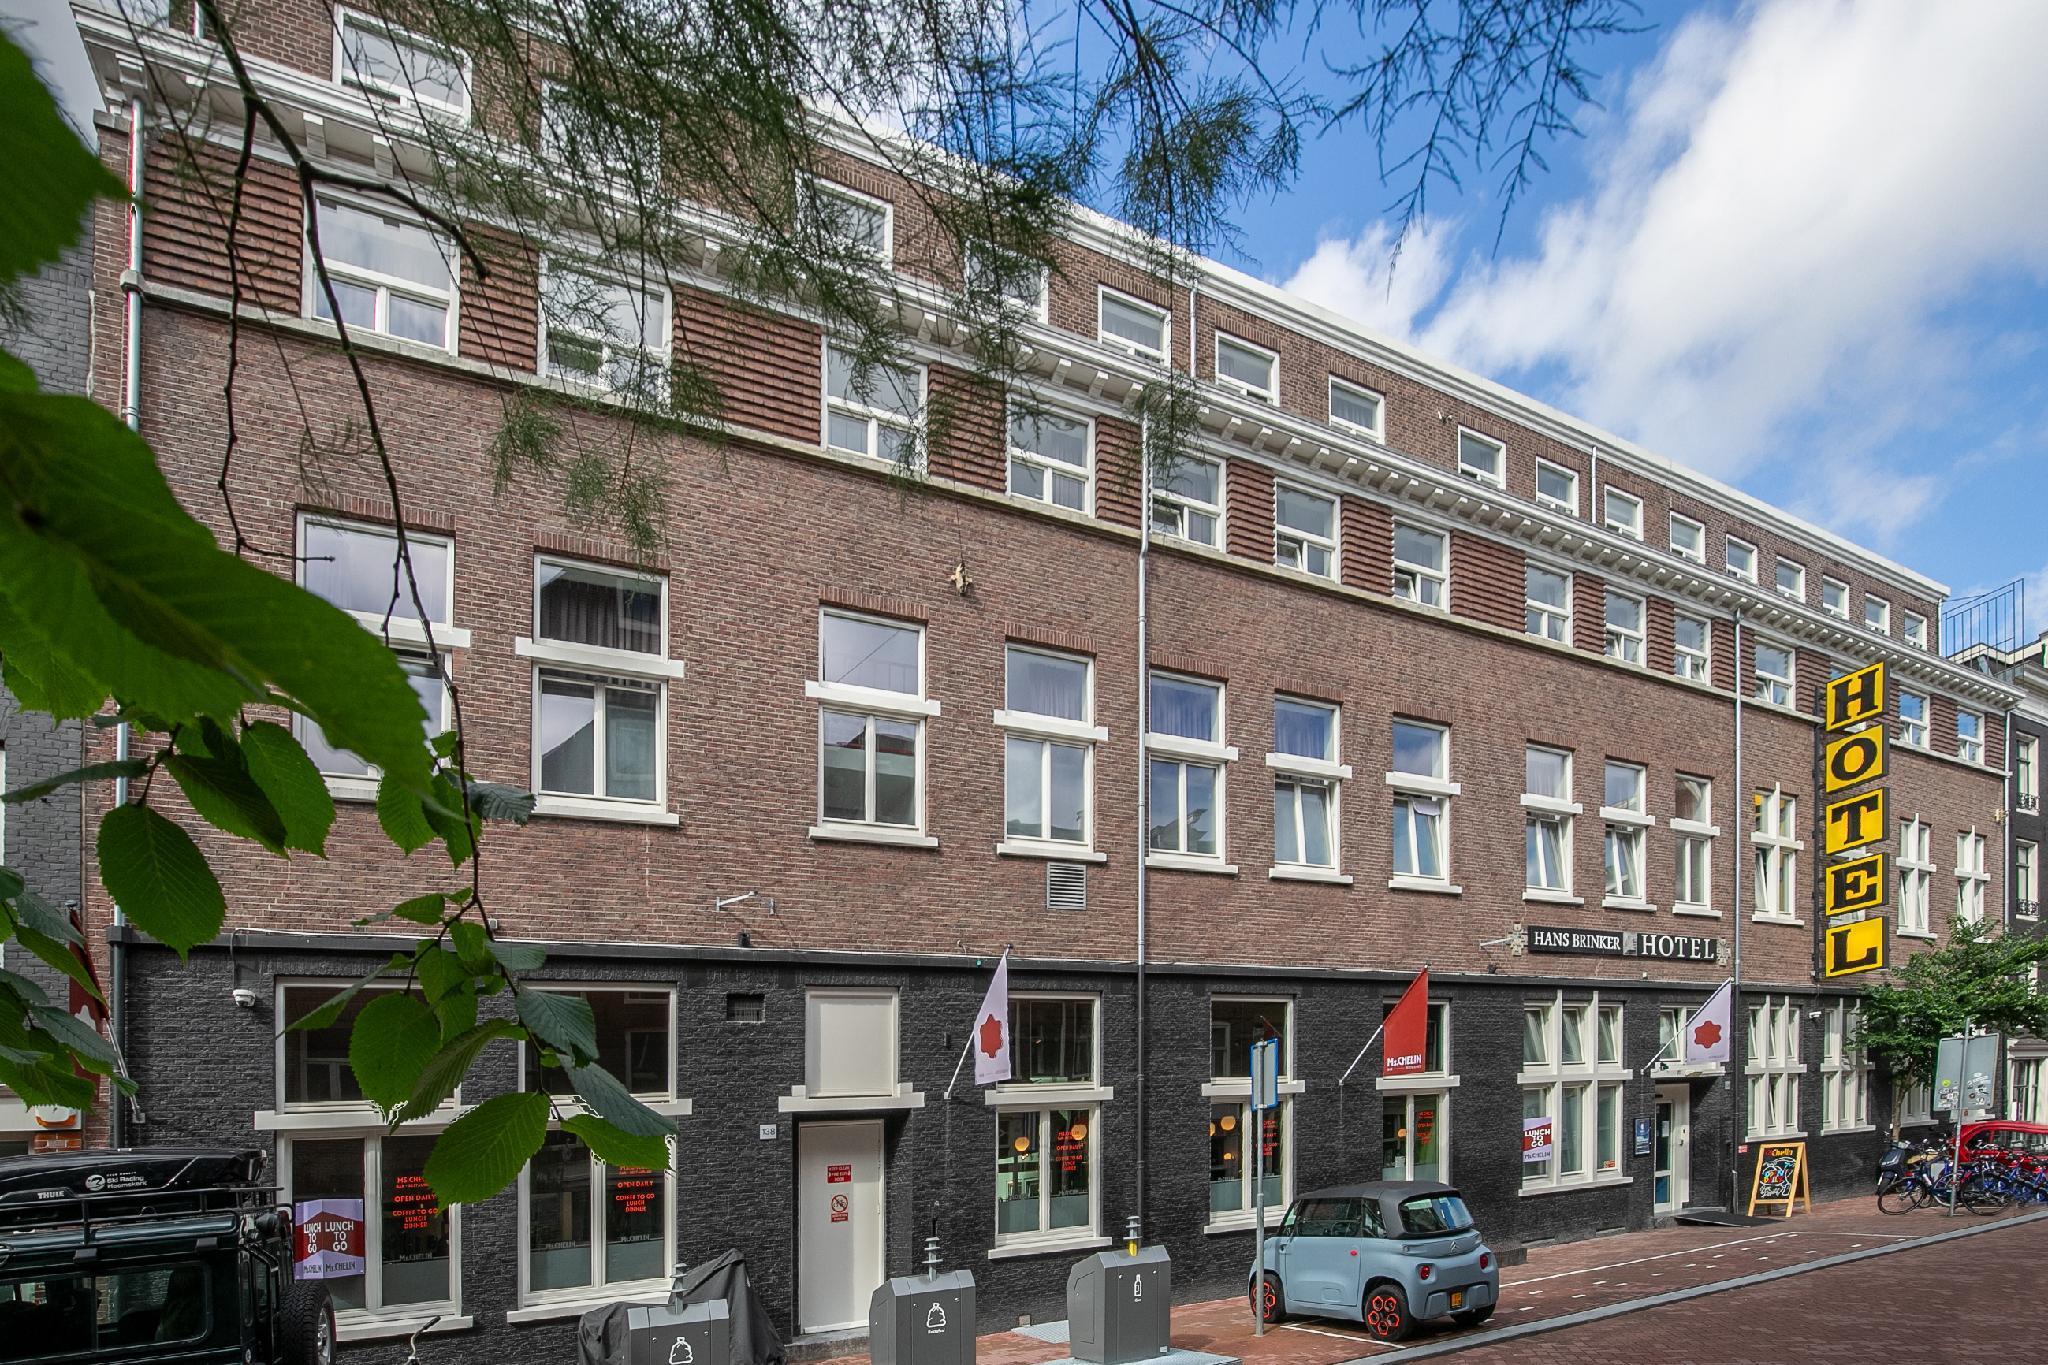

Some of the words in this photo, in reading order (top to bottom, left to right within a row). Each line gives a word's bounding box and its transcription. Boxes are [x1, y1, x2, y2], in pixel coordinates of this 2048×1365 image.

[1830, 667, 1880, 973] HOTEL
[1534, 931, 1570, 947] HANS
[1572, 933, 1621, 950] BRINKER
[1641, 934, 1716, 960] HOTEL
[1524, 1129, 1551, 1137] LUNCH
[38, 1190, 64, 1199] THULE
[304, 1222, 321, 1233] LUNCH
[325, 1221, 354, 1232] LUNCH
[309, 1233, 316, 1243] TO
[334, 1231, 346, 1241] TO
[307, 1244, 317, 1253] GO
[333, 1241, 348, 1252] GO
